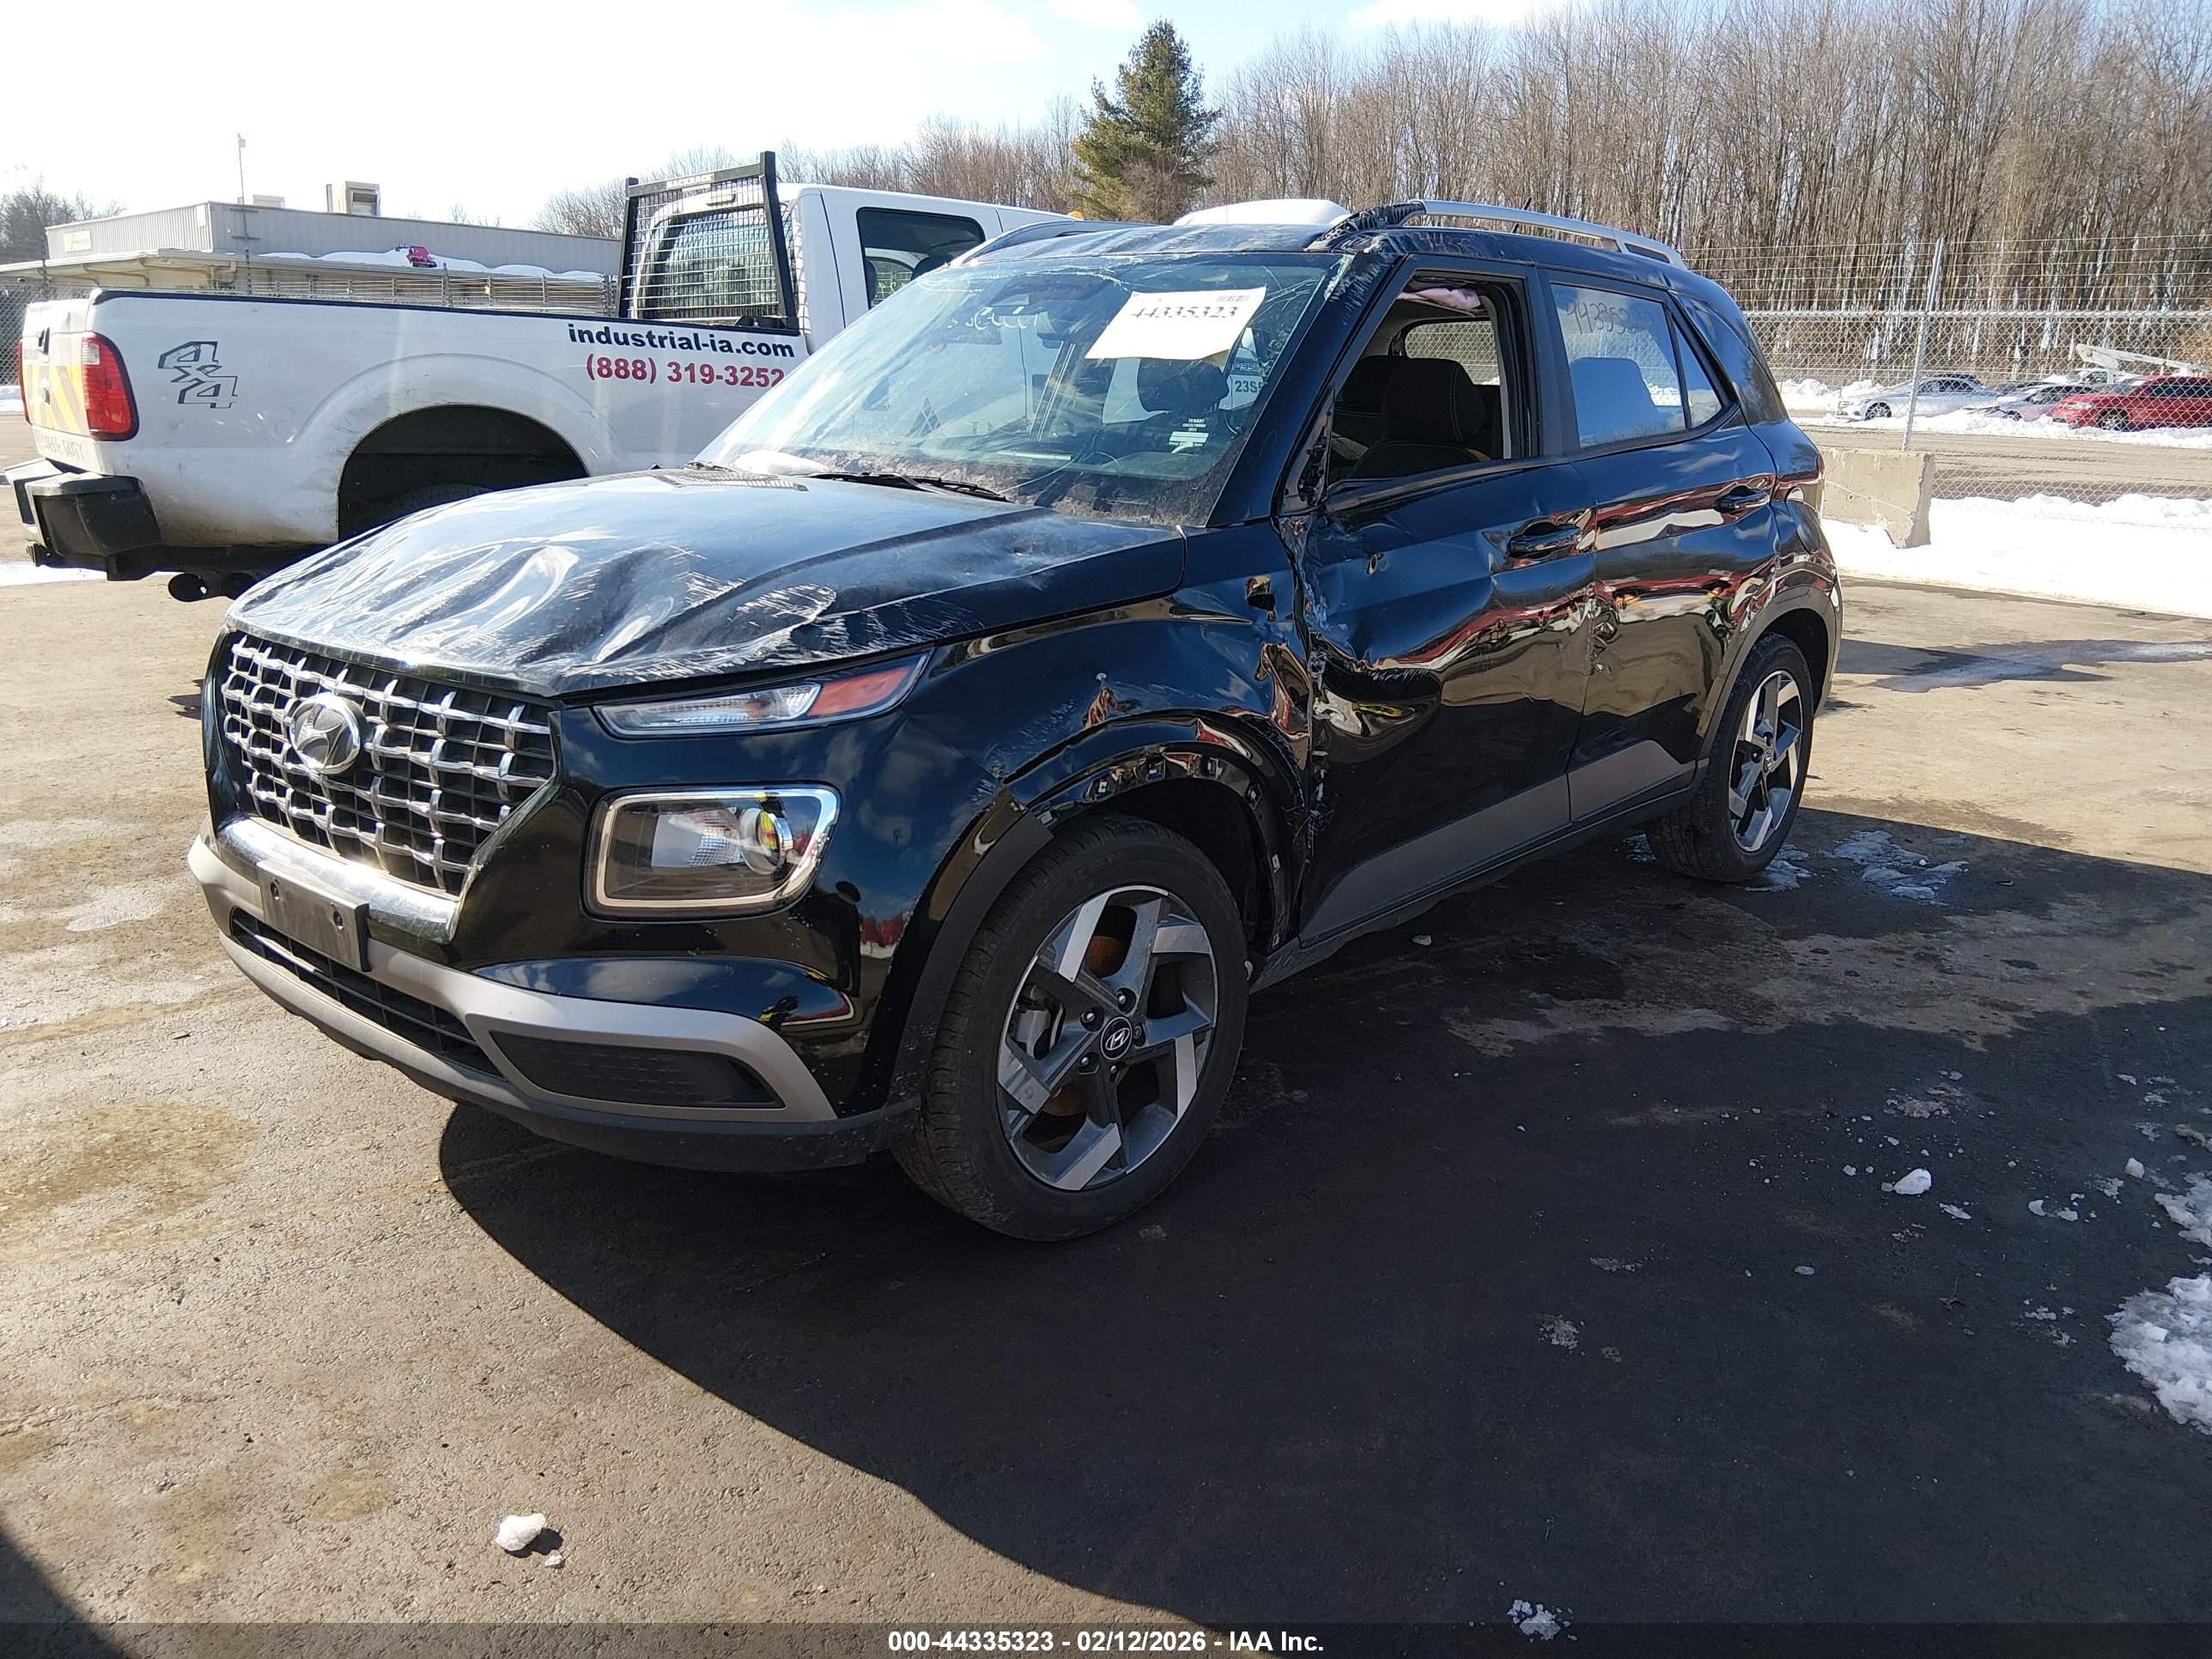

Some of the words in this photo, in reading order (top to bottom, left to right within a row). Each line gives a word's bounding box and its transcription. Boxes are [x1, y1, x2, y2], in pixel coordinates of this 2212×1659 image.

[568, 324, 795, 358] industrial-ia.com
[586, 353, 657, 384] (888)
[667, 361, 785, 388] 319-3252
